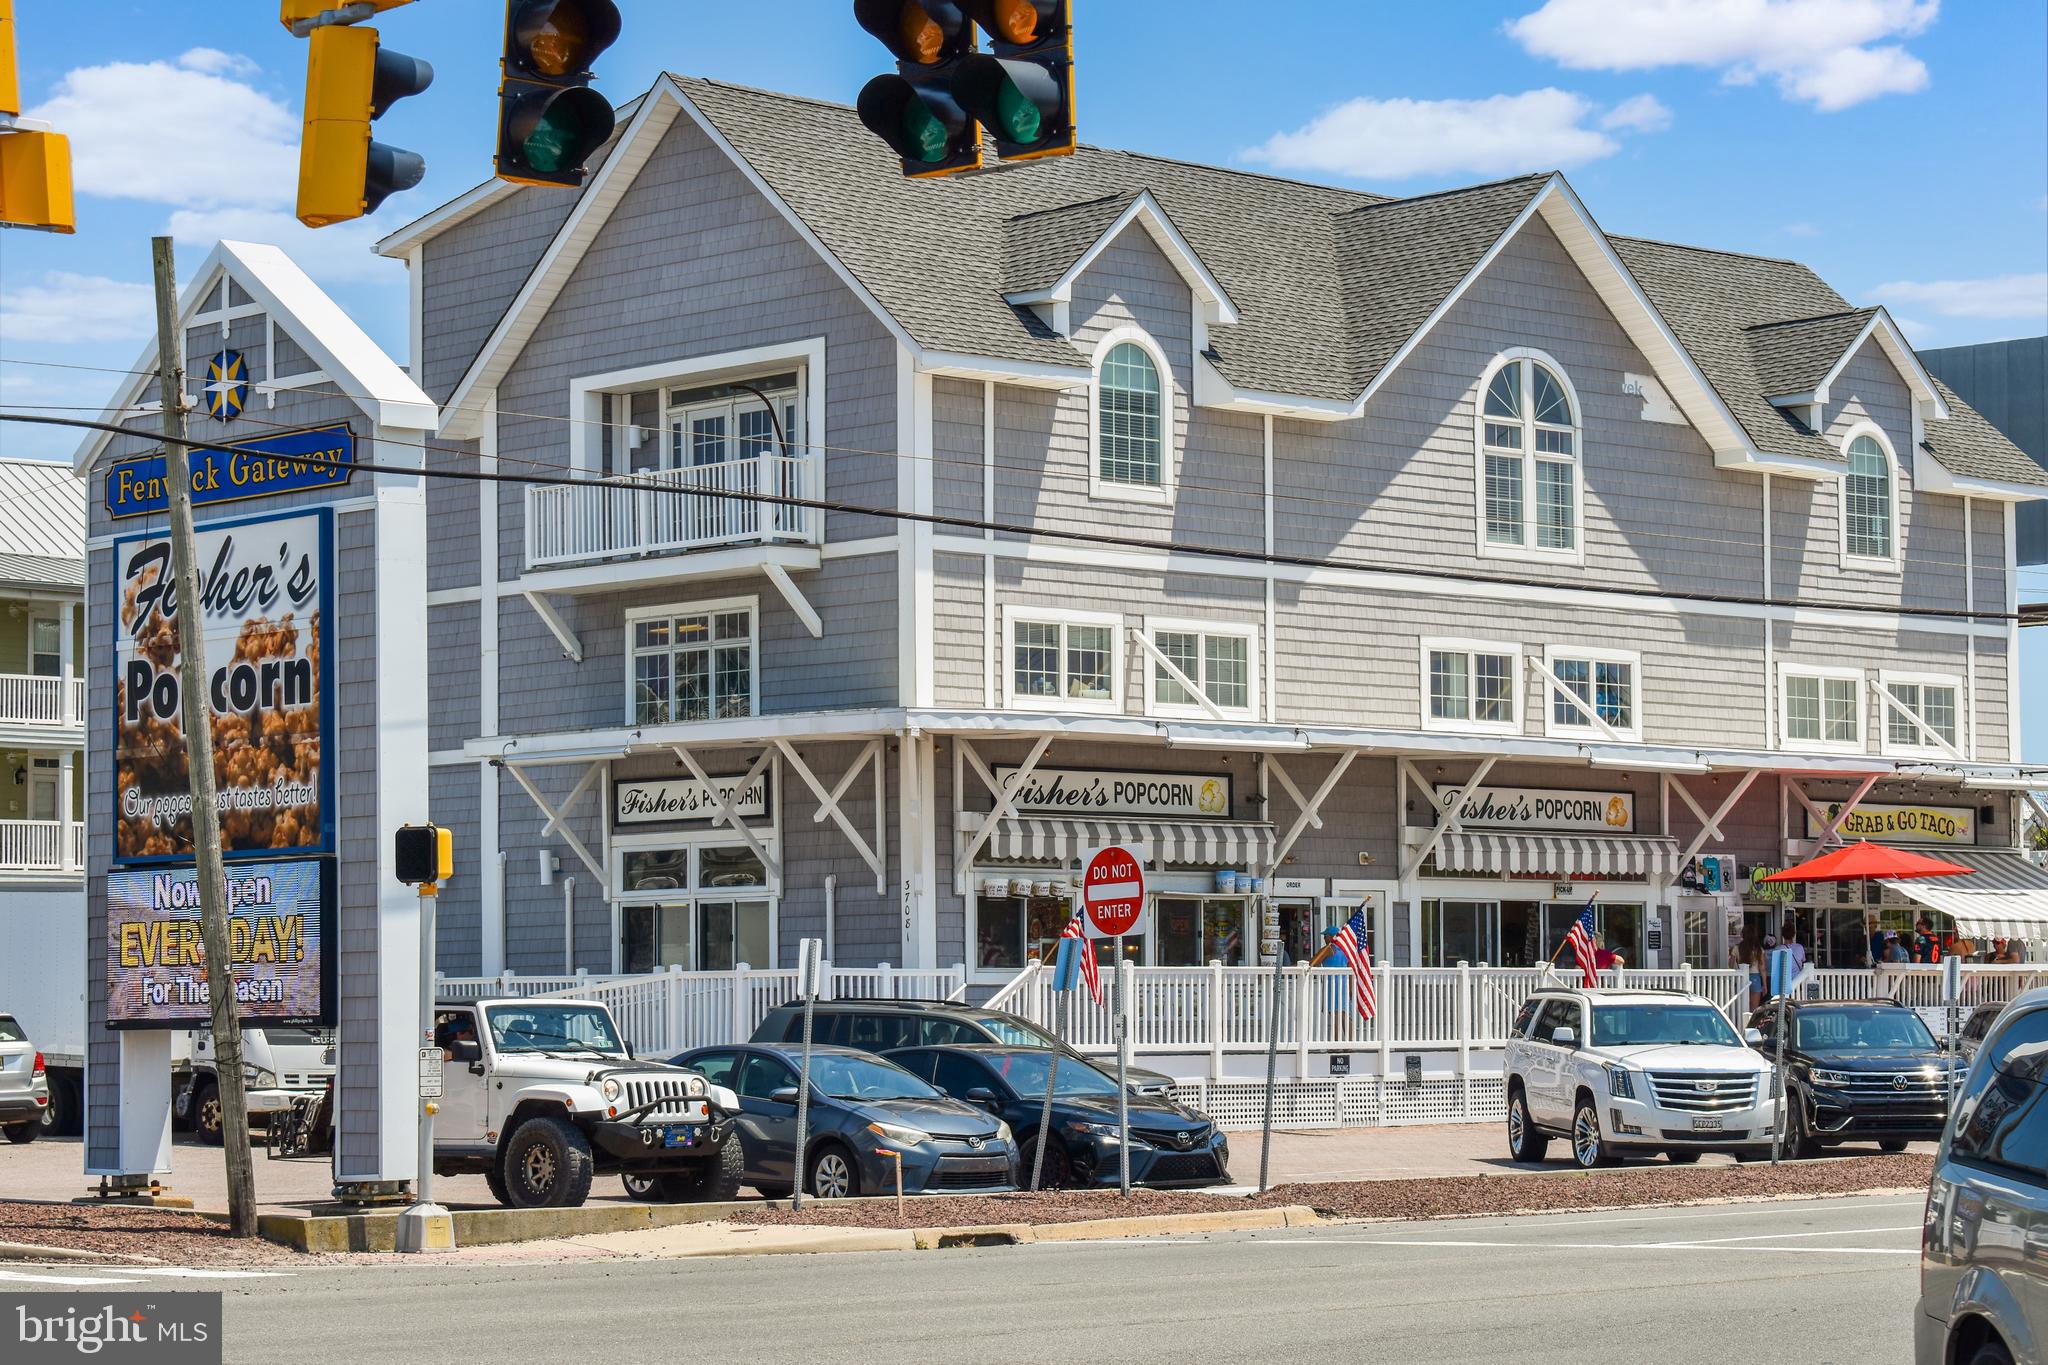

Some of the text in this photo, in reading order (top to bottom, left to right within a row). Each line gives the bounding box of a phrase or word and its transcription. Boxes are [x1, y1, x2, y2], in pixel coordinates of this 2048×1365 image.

[117, 447, 344, 504] Fenck Gateway
[126, 535, 316, 636] Fiher's
[124, 788, 153, 817] Our
[153, 796, 193, 826] popco
[234, 784, 272, 809] tastes
[275, 772, 318, 805] better!
[621, 787, 700, 815] Fisher's
[1113, 780, 1194, 807] POPCORN
[1535, 798, 1603, 822] POPCORN
[1844, 810, 1956, 837] GRAB & GO TACO
[1093, 863, 1133, 880] DO NOT
[224, 876, 271, 915] pen
[1097, 903, 1132, 919] ENTER
[1931, 943, 1939, 964] 6
[141, 974, 284, 1006] For The ason
[1331, 1064, 1349, 1073] PARKING
[1336, 1057, 1344, 1065] NO
